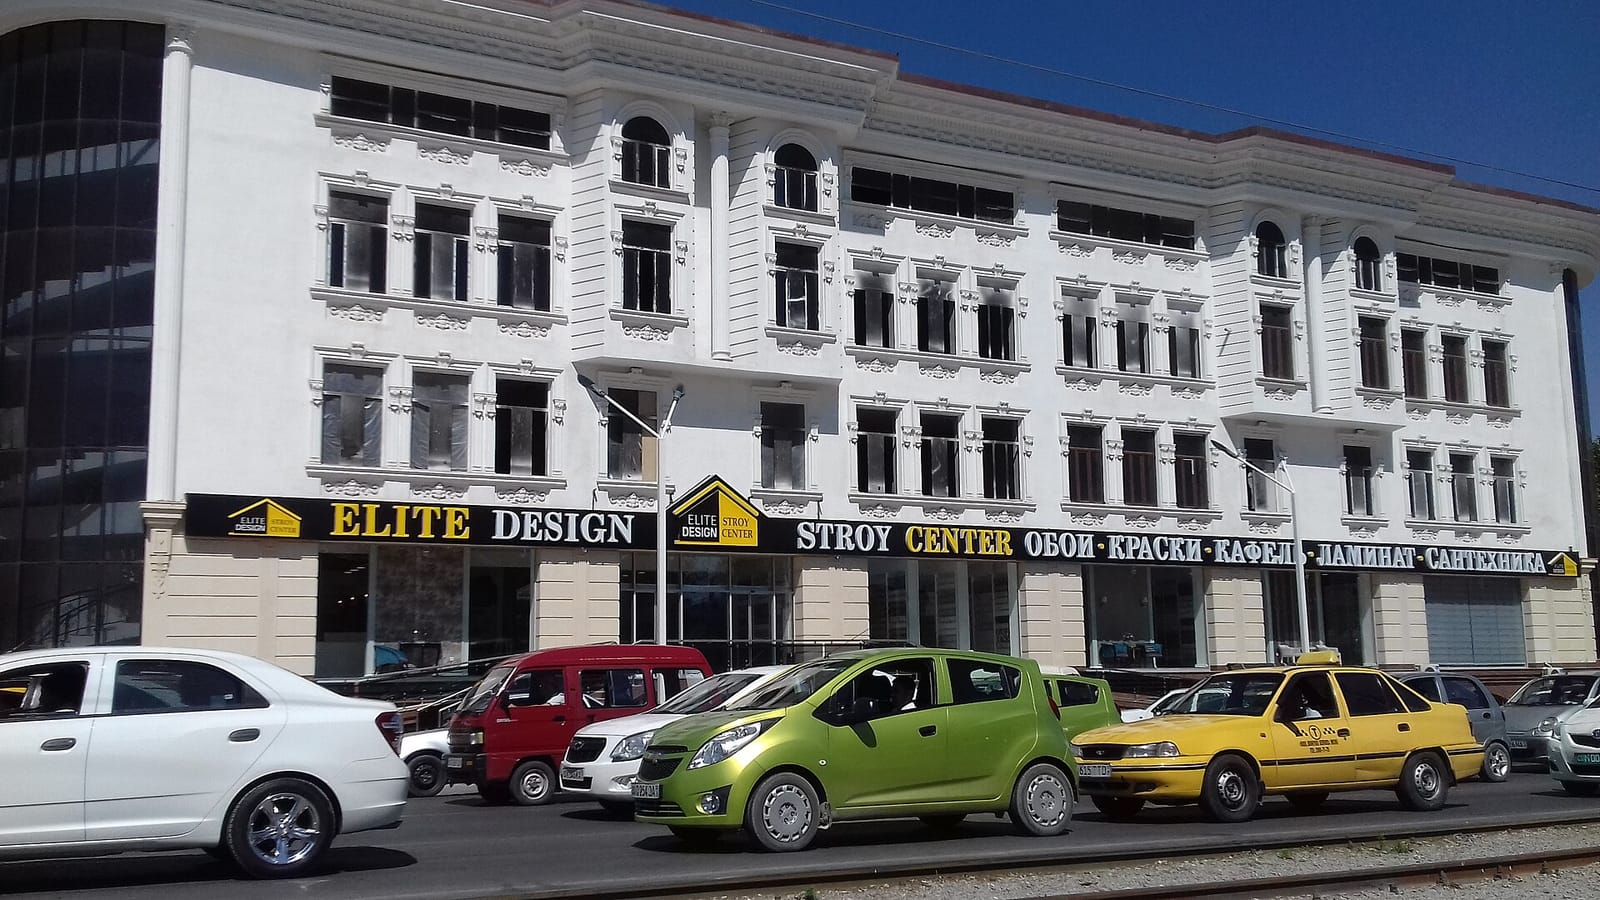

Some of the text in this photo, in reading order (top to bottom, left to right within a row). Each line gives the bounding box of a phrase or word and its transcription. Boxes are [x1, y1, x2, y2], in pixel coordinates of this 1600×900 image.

[240, 516, 265, 524] ELITE
[329, 503, 635, 544] ELITE DESIGN
[687, 514, 718, 526] ELITE
[722, 517, 750, 527] STROY
[682, 526, 718, 538] DESIGN
[721, 528, 753, 539] CENTER
[796, 521, 1013, 556] STROY CENTER
[1024, 531, 1097, 558] ОБОИ
[1106, 534, 1203, 562] КРАСКИ
[1316, 543, 1417, 569] ЛАМИНАТ
[1423, 549, 1547, 573] САНТЕХНИКА
